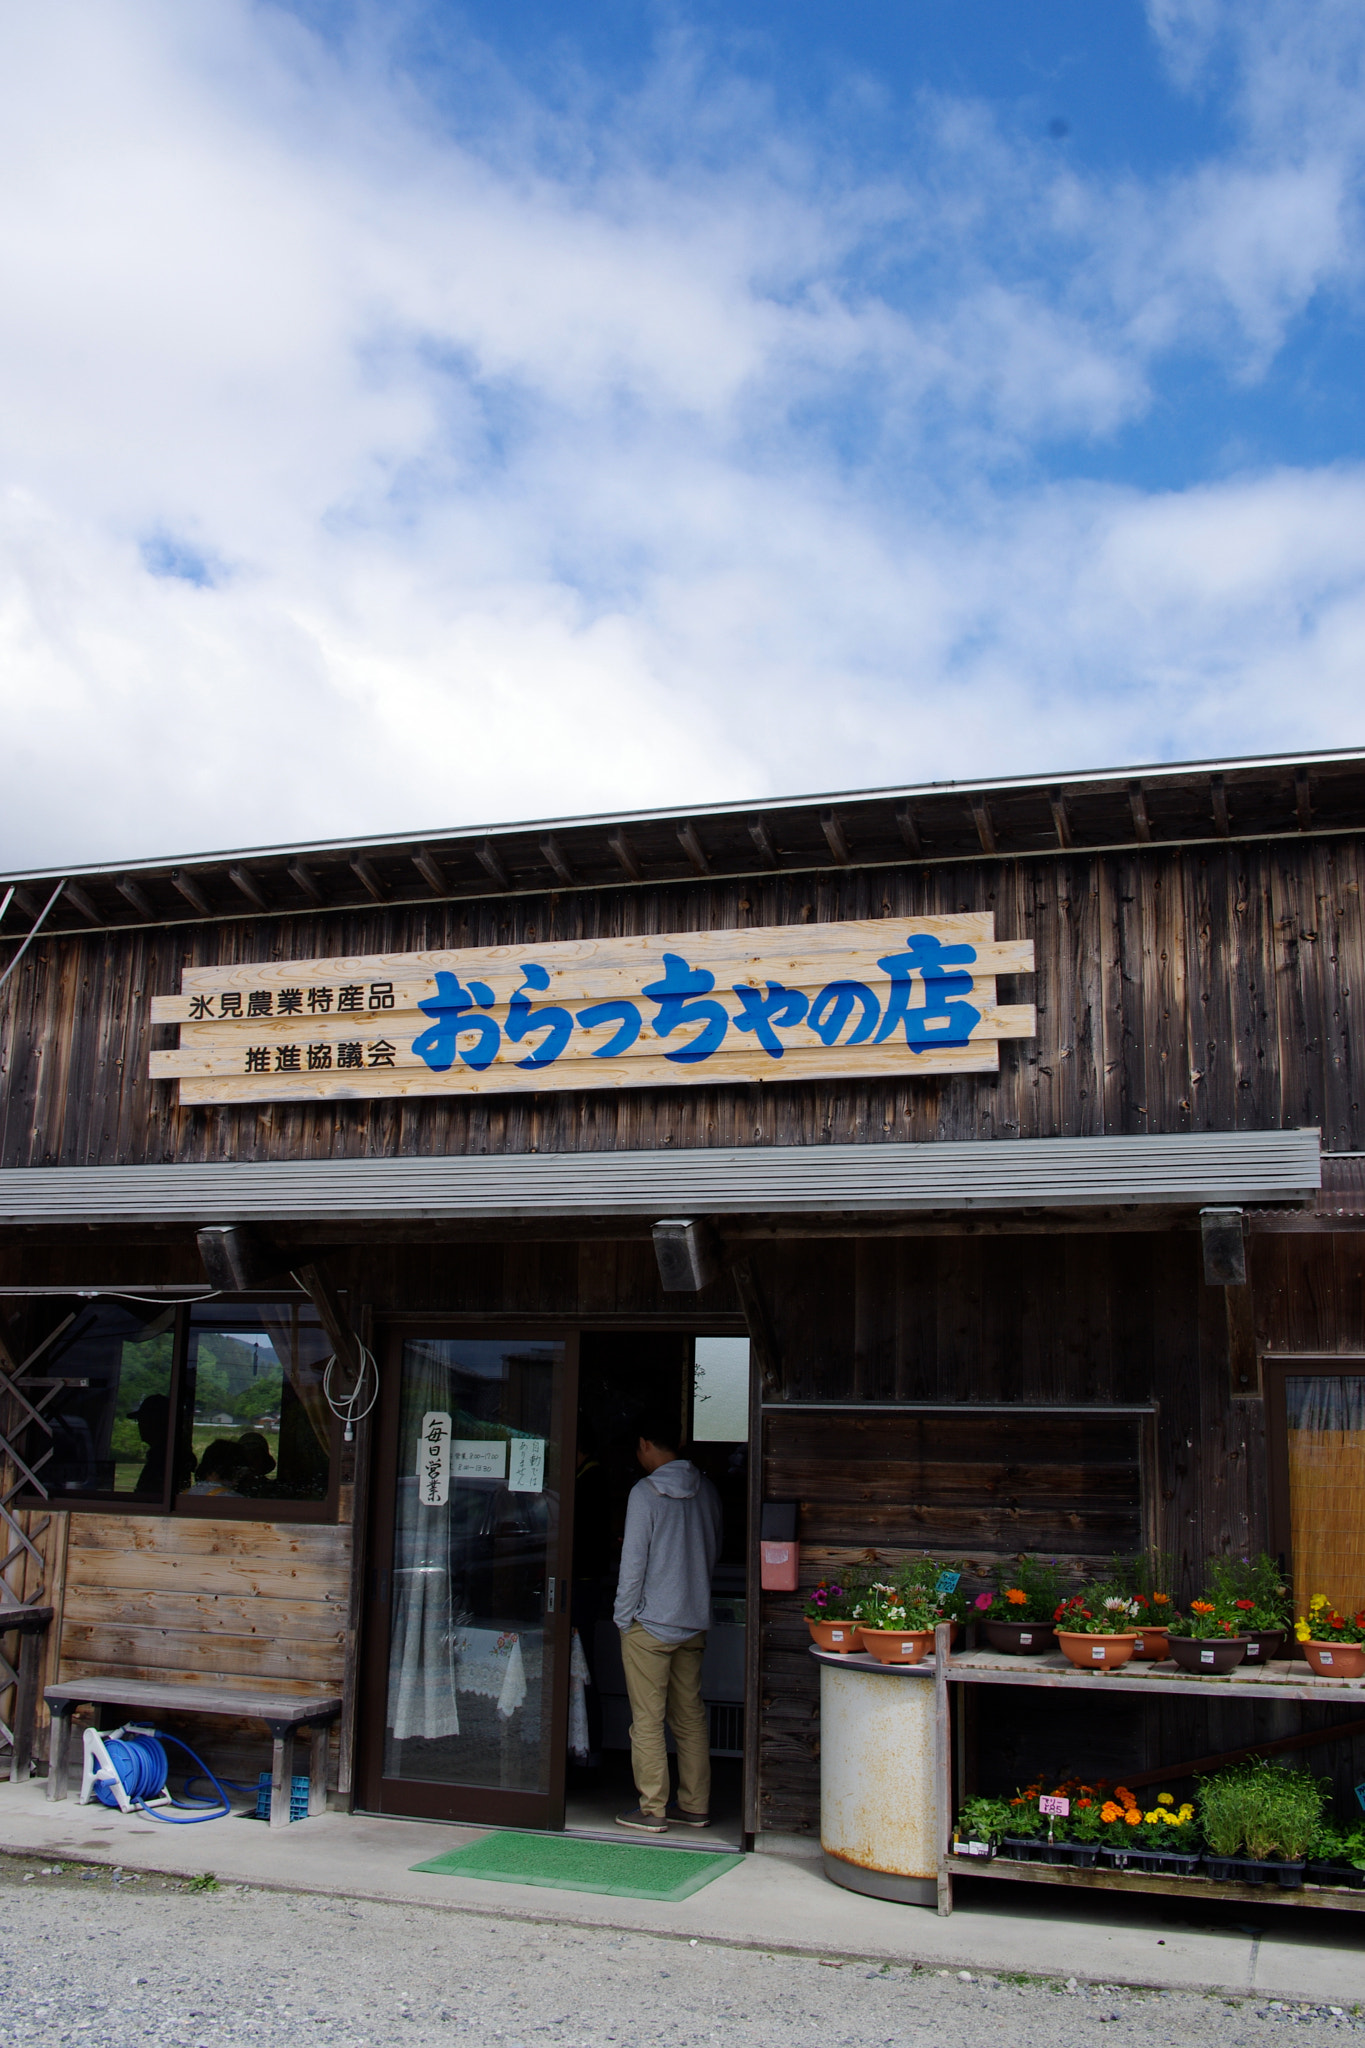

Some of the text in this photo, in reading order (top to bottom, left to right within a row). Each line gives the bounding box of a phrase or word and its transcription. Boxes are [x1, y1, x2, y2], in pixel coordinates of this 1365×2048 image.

[188, 982, 395, 1020] 氷見農業特産品
[412, 933, 981, 1072] おらっちゃの店
[244, 1039, 396, 1073] 推進協議会
[424, 1419, 448, 1502] 毎日営業
